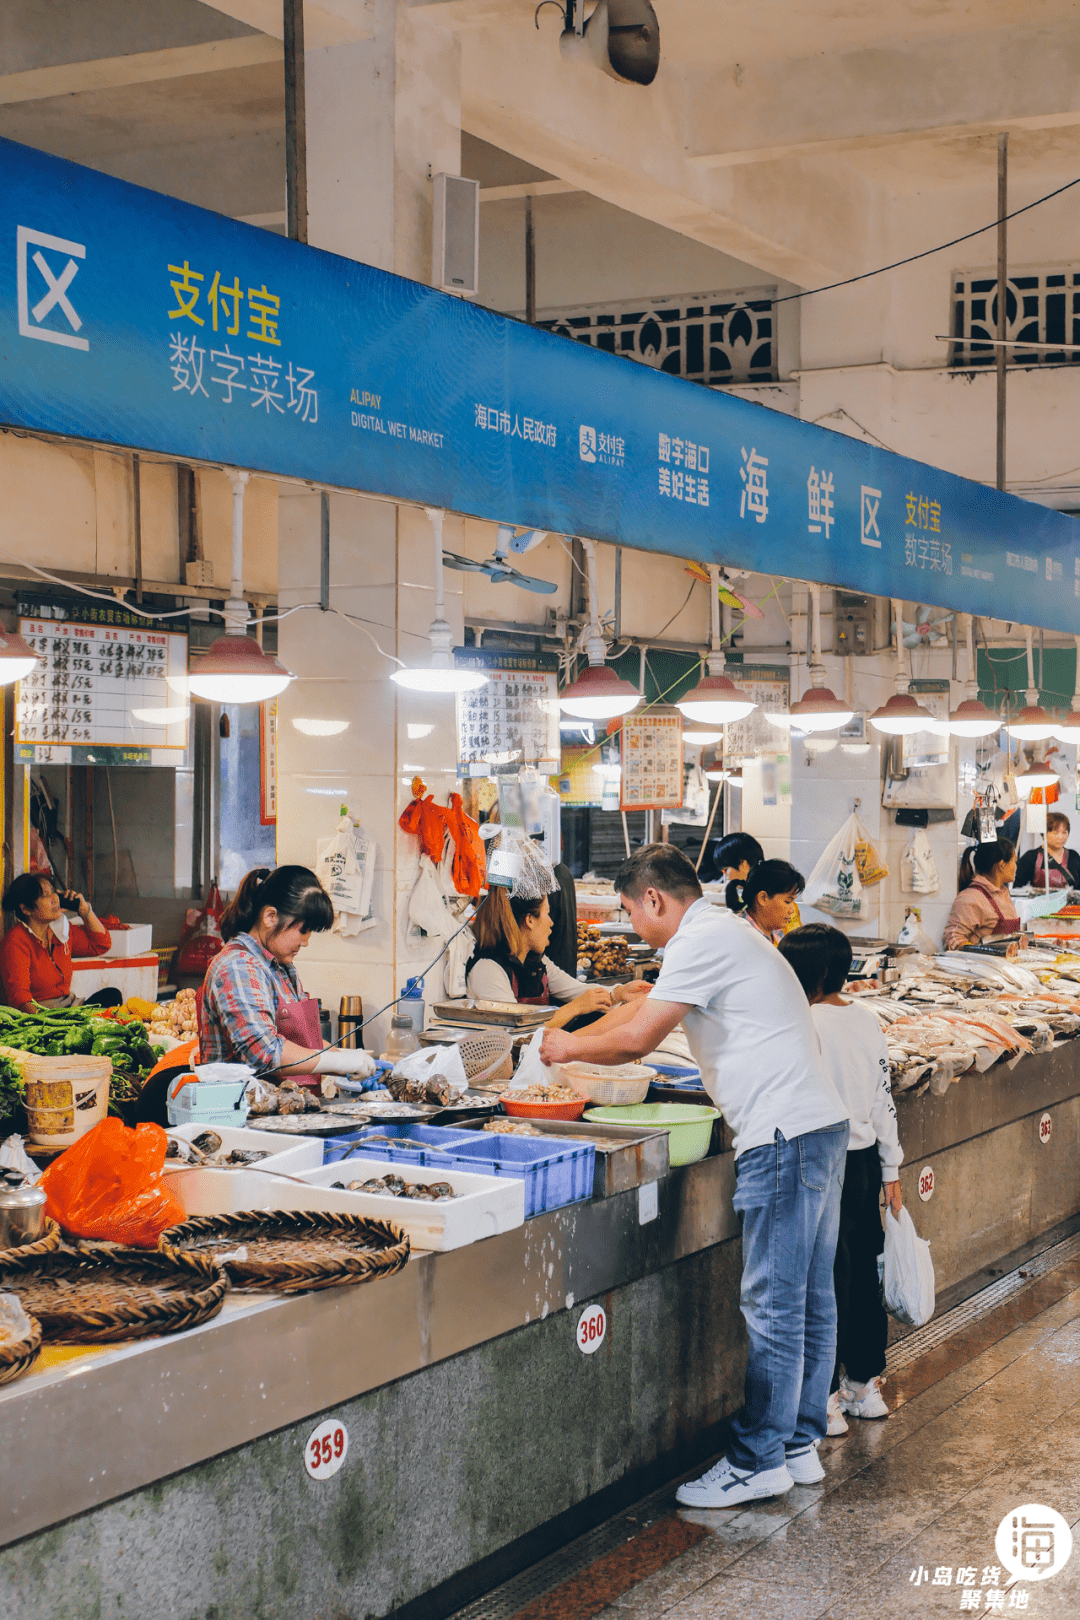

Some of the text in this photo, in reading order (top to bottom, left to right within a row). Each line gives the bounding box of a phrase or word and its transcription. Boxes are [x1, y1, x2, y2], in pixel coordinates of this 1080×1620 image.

[17, 225, 90, 351] 区
[168, 261, 281, 346] 支付宝
[168, 331, 319, 424] 数字菜场
[350, 388, 381, 410] ALIPAY
[351, 411, 444, 448] DIGITAL WET MARKET
[474, 403, 557, 447] 海口市人民政府
[598, 432, 625, 457] 支付宝
[598, 455, 625, 467] ALIPAY
[658, 431, 710, 473] 数字海口
[658, 467, 710, 507] 美好生活
[905, 491, 941, 533] 支付宝
[905, 532, 953, 575] 数字菜场
[920, 1173, 934, 1194] 362
[580, 1313, 604, 1345] 360
[310, 1428, 345, 1469] 359
